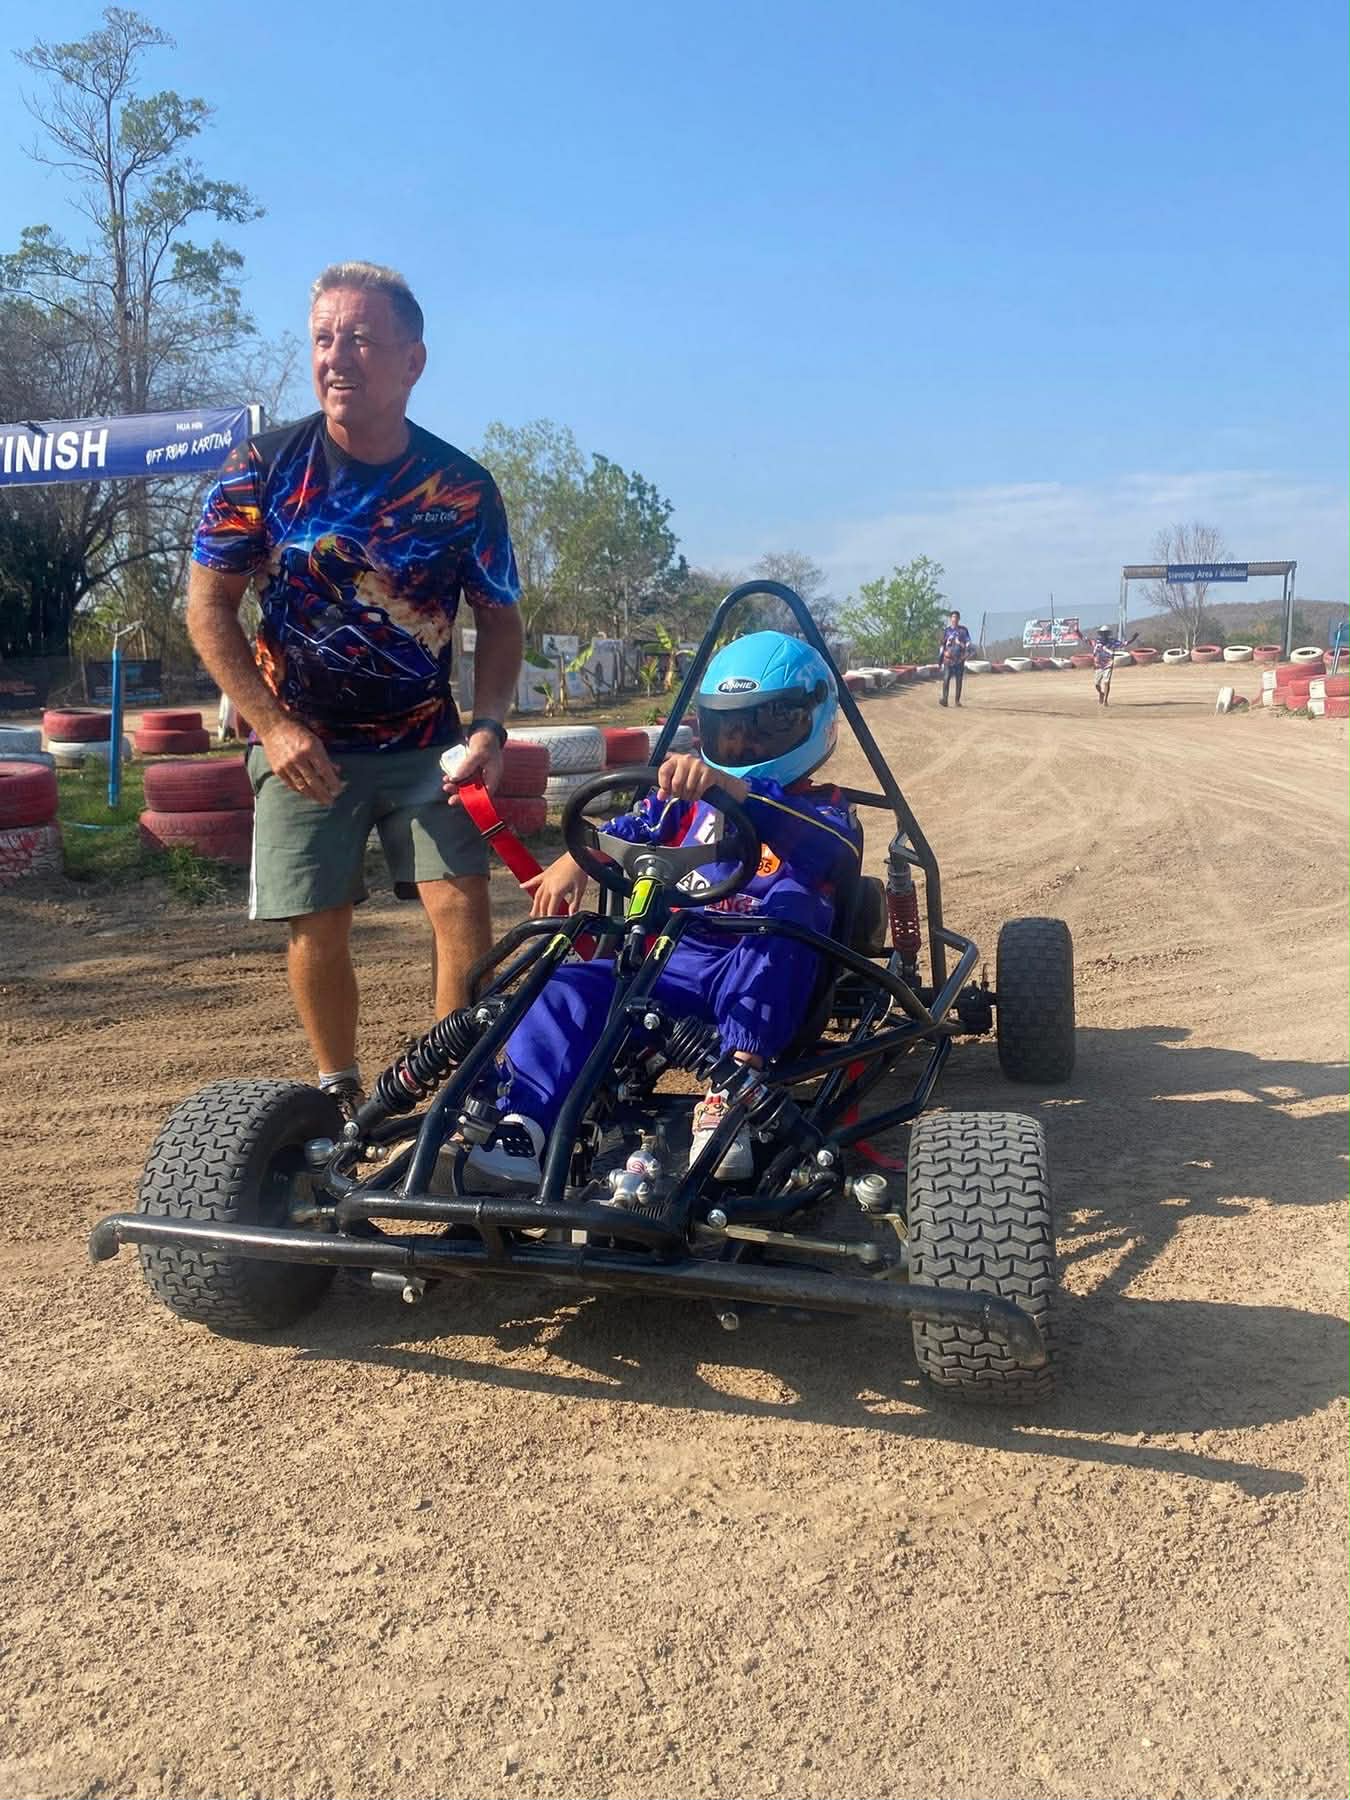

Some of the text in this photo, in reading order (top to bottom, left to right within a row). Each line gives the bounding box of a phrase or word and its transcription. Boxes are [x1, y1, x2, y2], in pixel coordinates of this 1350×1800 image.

[0, 429, 108, 473] INISH
[146, 429, 232, 466] OFF ROAD KARTING
[1196, 569, 1214, 578] Area
